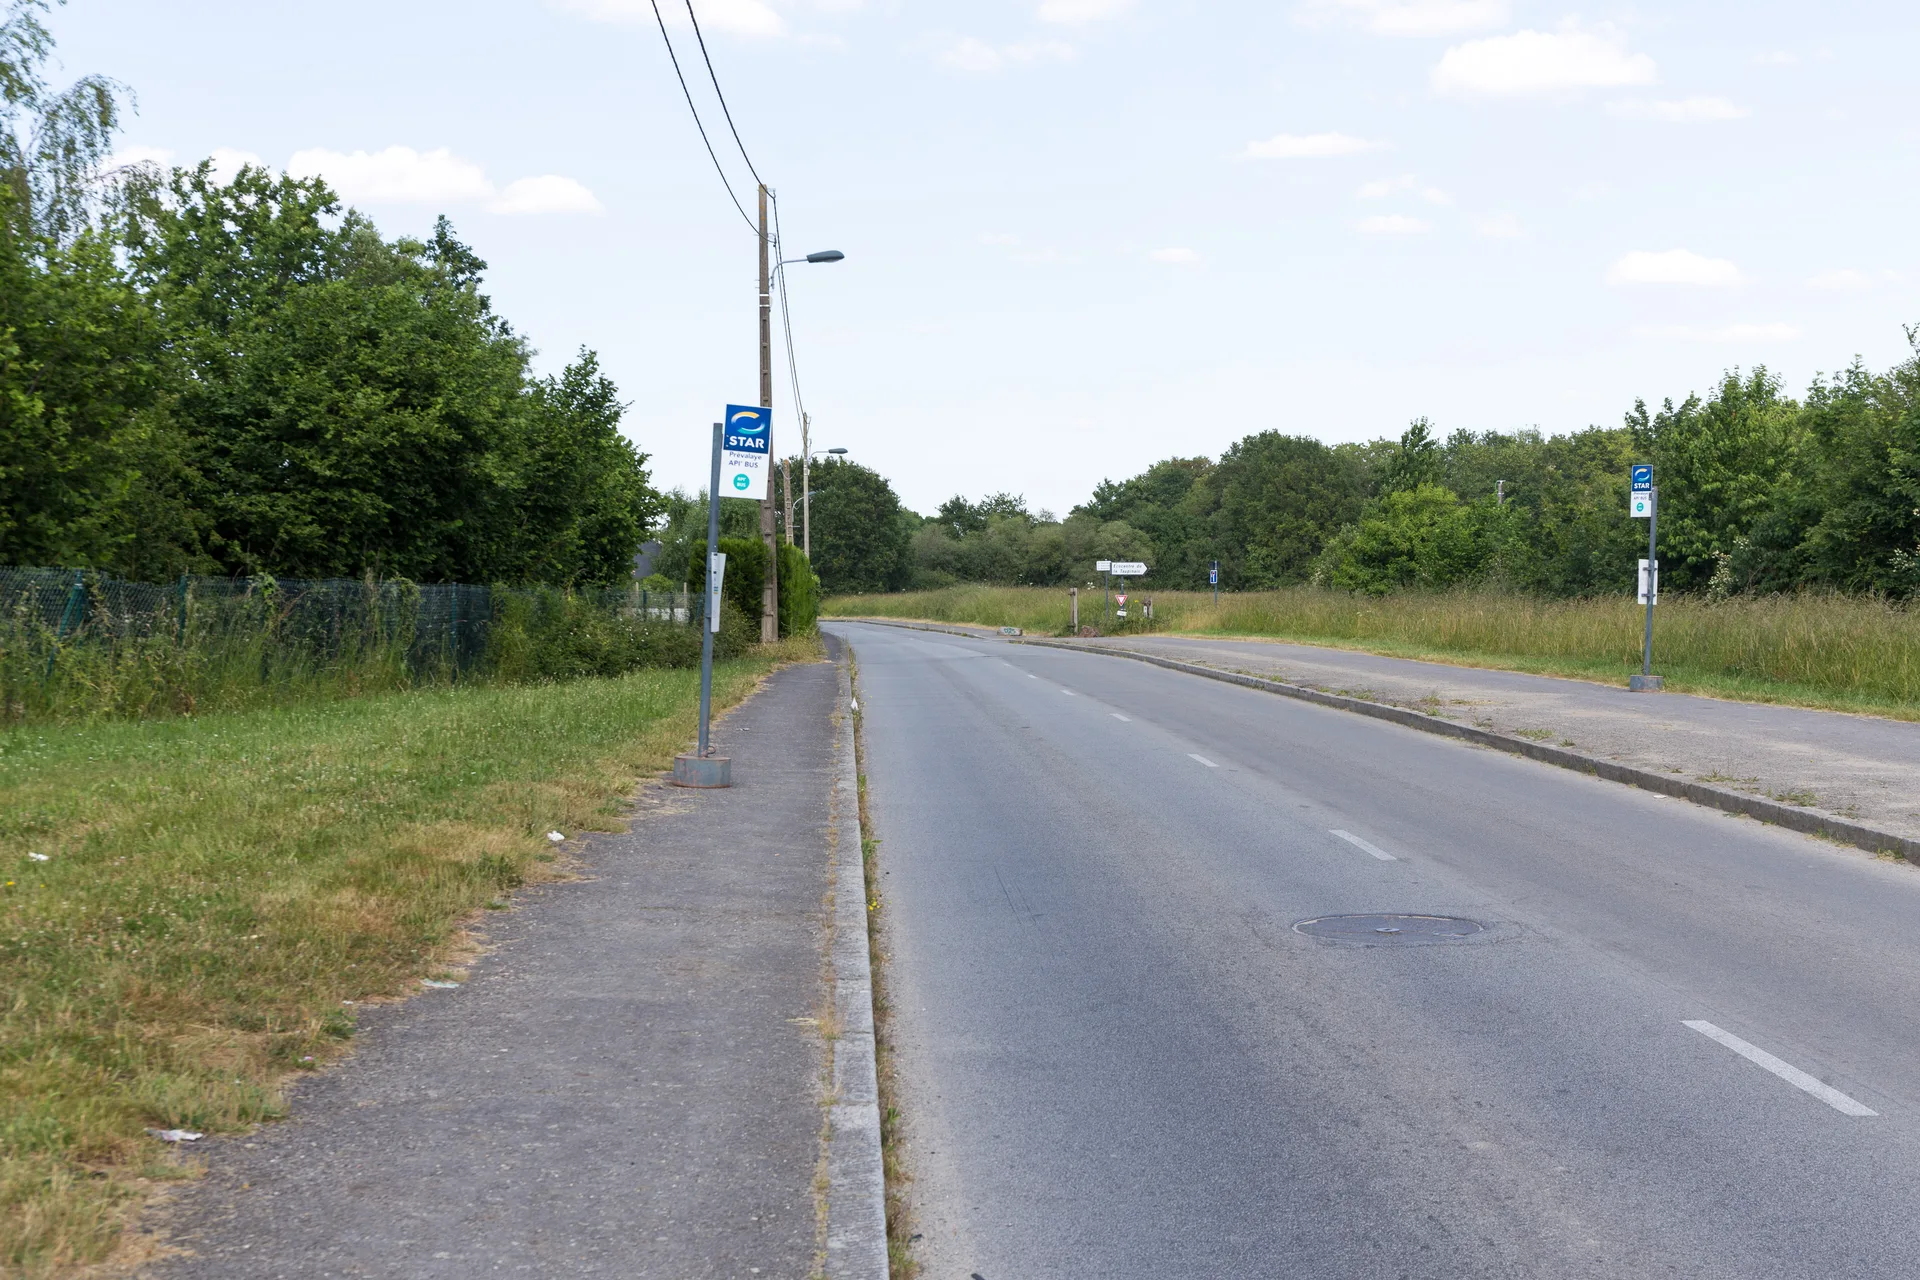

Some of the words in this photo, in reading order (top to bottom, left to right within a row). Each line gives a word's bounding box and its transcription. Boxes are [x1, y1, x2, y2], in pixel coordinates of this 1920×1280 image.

[729, 435, 764, 449] STAR
[729, 451, 762, 461] Prévalaye
[744, 460, 759, 468] BUS
